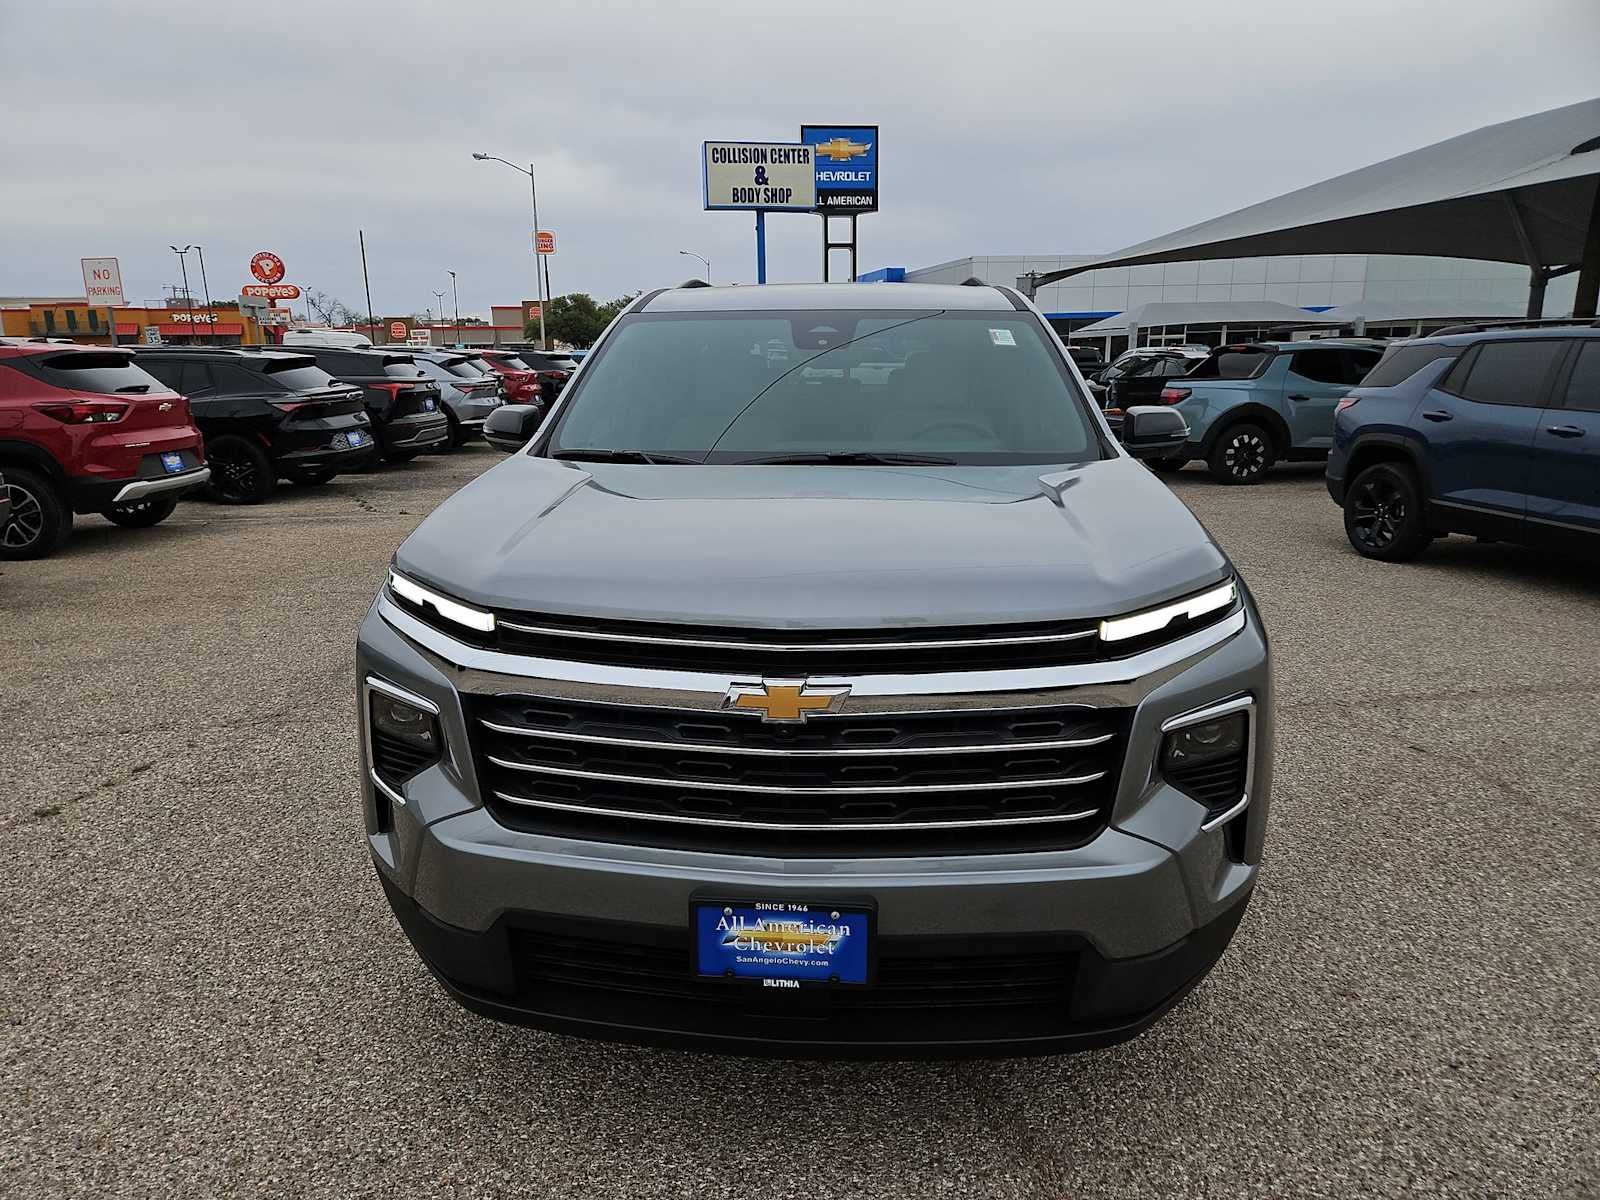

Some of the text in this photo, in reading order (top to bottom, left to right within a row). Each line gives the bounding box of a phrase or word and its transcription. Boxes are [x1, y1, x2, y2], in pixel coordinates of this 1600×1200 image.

[711, 147, 810, 164] COLLISION CENTER
[754, 165, 769, 186] &
[816, 171, 871, 182] HEVROLET
[732, 187, 792, 204] BODY SHOP
[827, 196, 873, 206] AMERICAN
[93, 269, 110, 280] NO
[88, 286, 121, 296] PARKING
[755, 902, 809, 912] SINCE 1946
[715, 915, 852, 937] All American
[734, 936, 835, 955] Chevrolet
[735, 955, 829, 967] SanAngeloChevy.com
